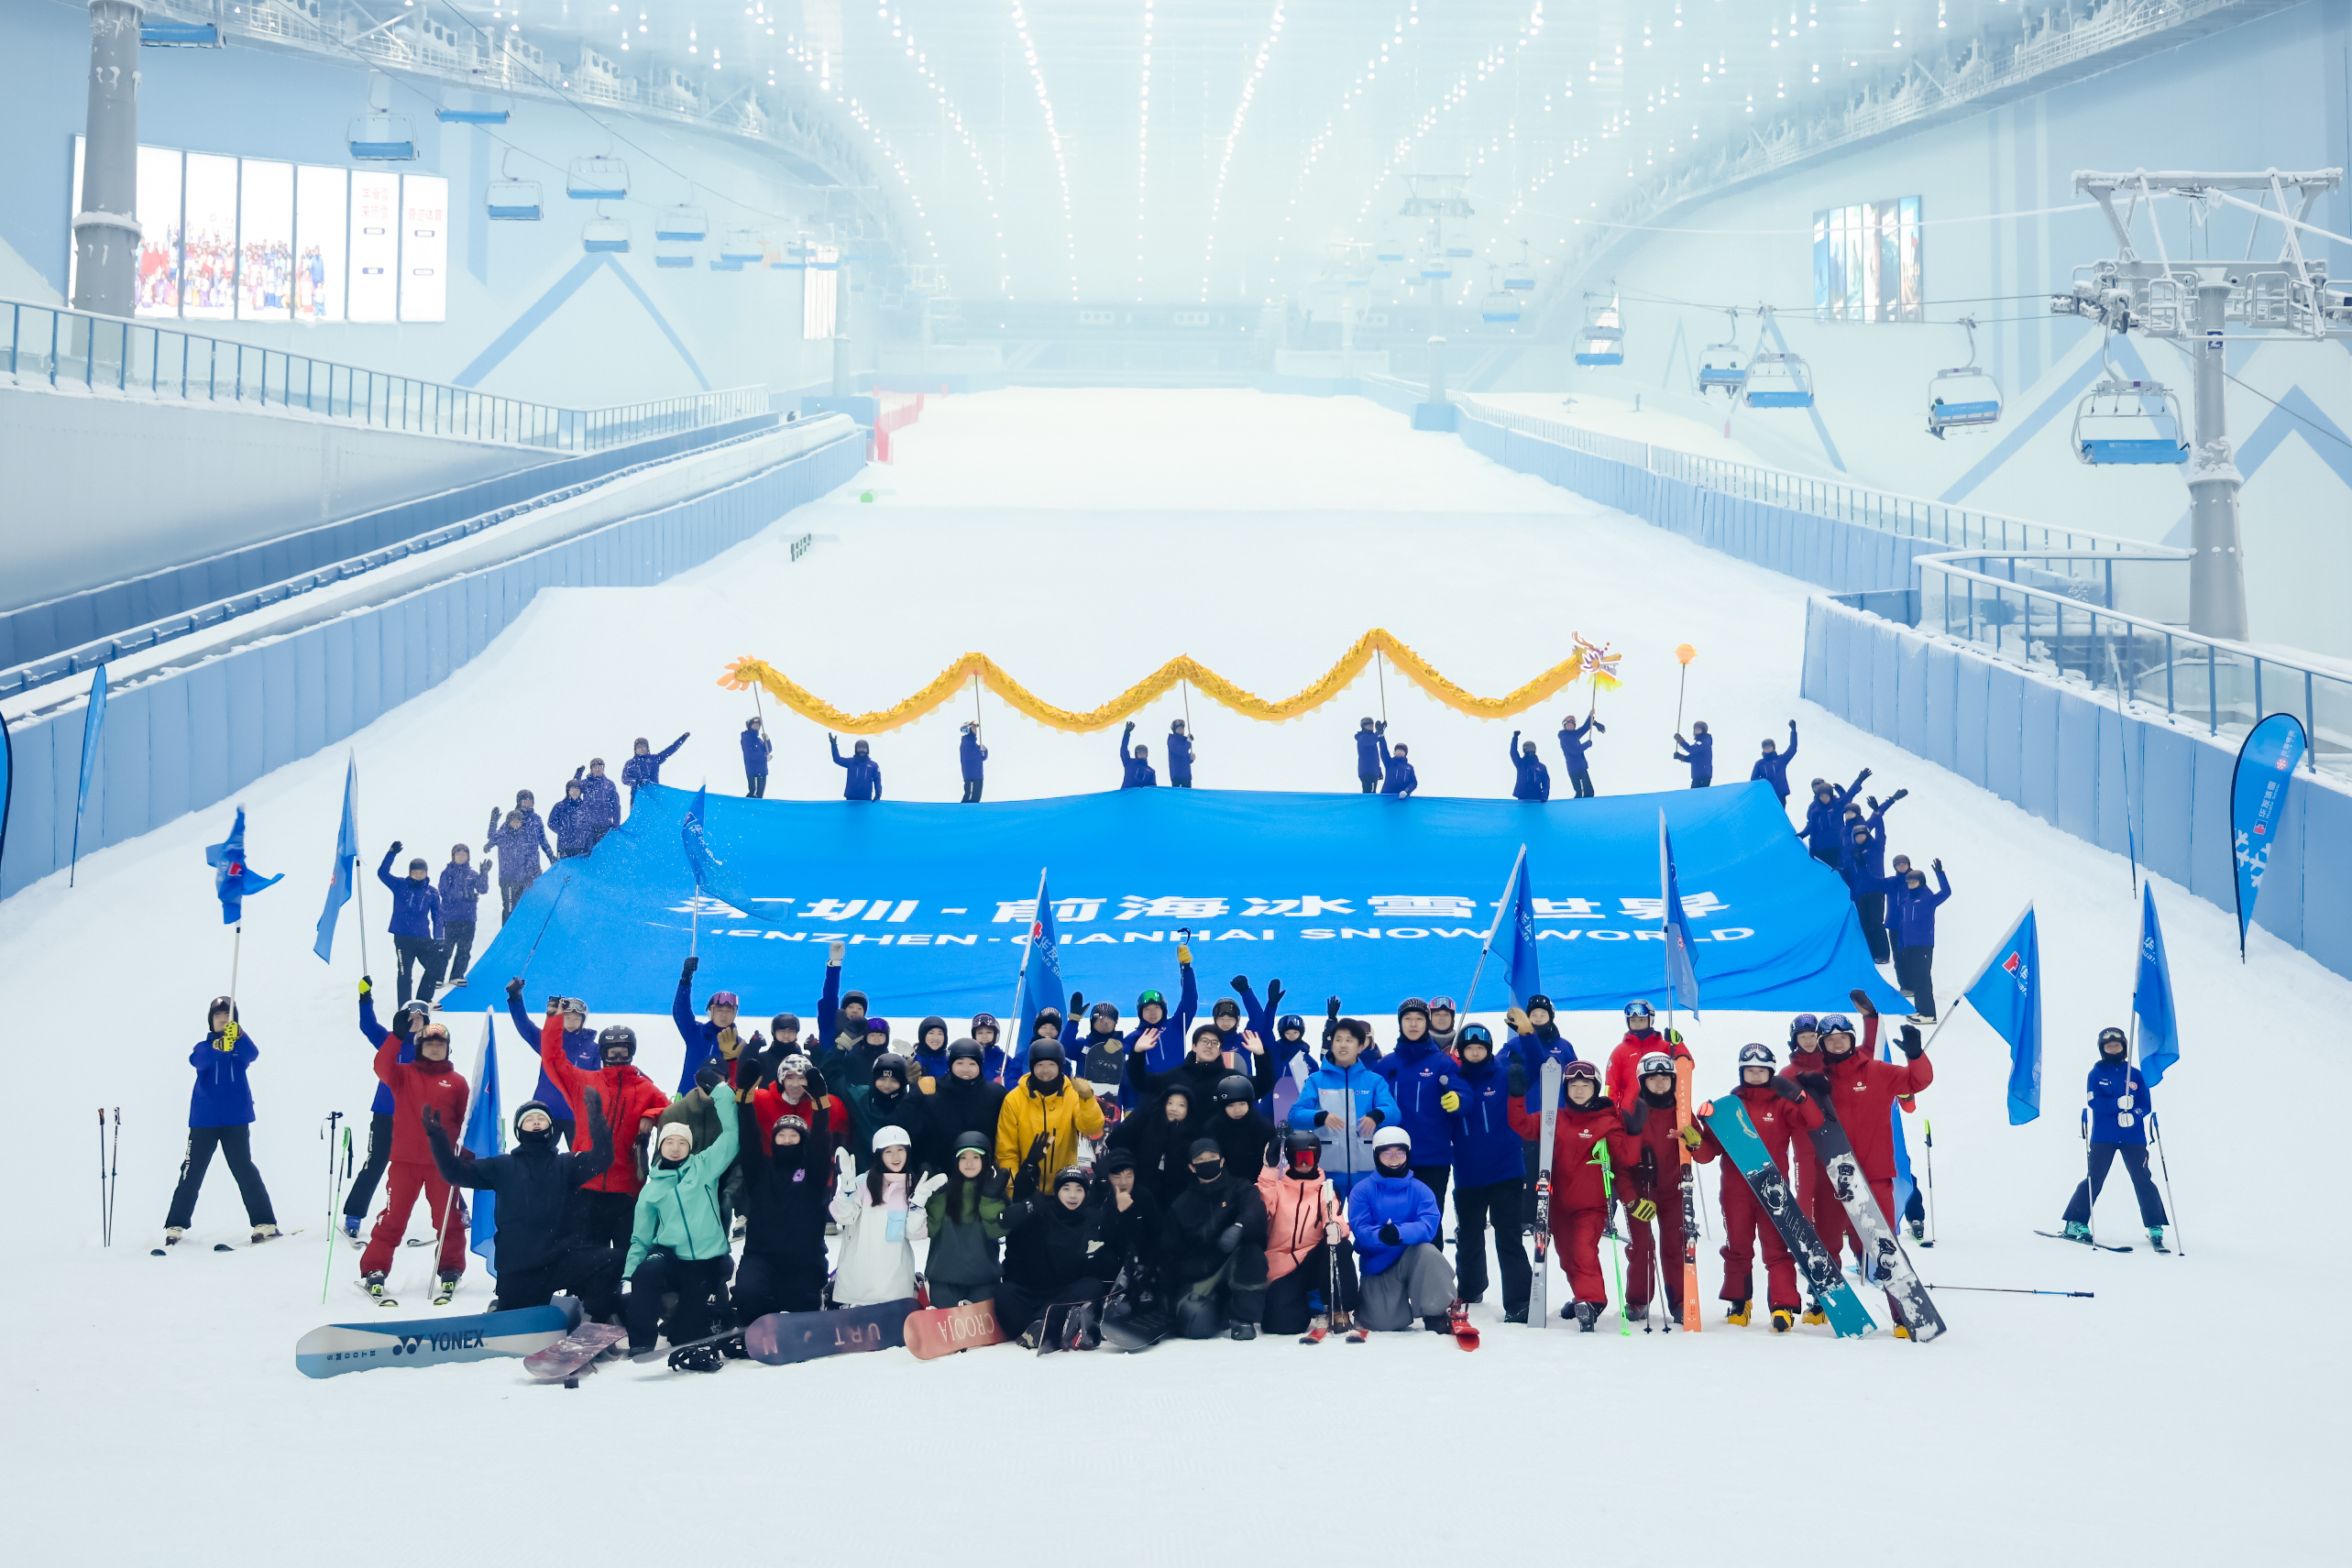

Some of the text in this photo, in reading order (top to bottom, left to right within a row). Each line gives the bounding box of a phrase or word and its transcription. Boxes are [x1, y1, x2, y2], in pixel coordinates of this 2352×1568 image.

[1300, 927, 1491, 939] SNOW
[937, 1311, 995, 1343] CROOJA
[428, 1328, 486, 1353] YONEX
